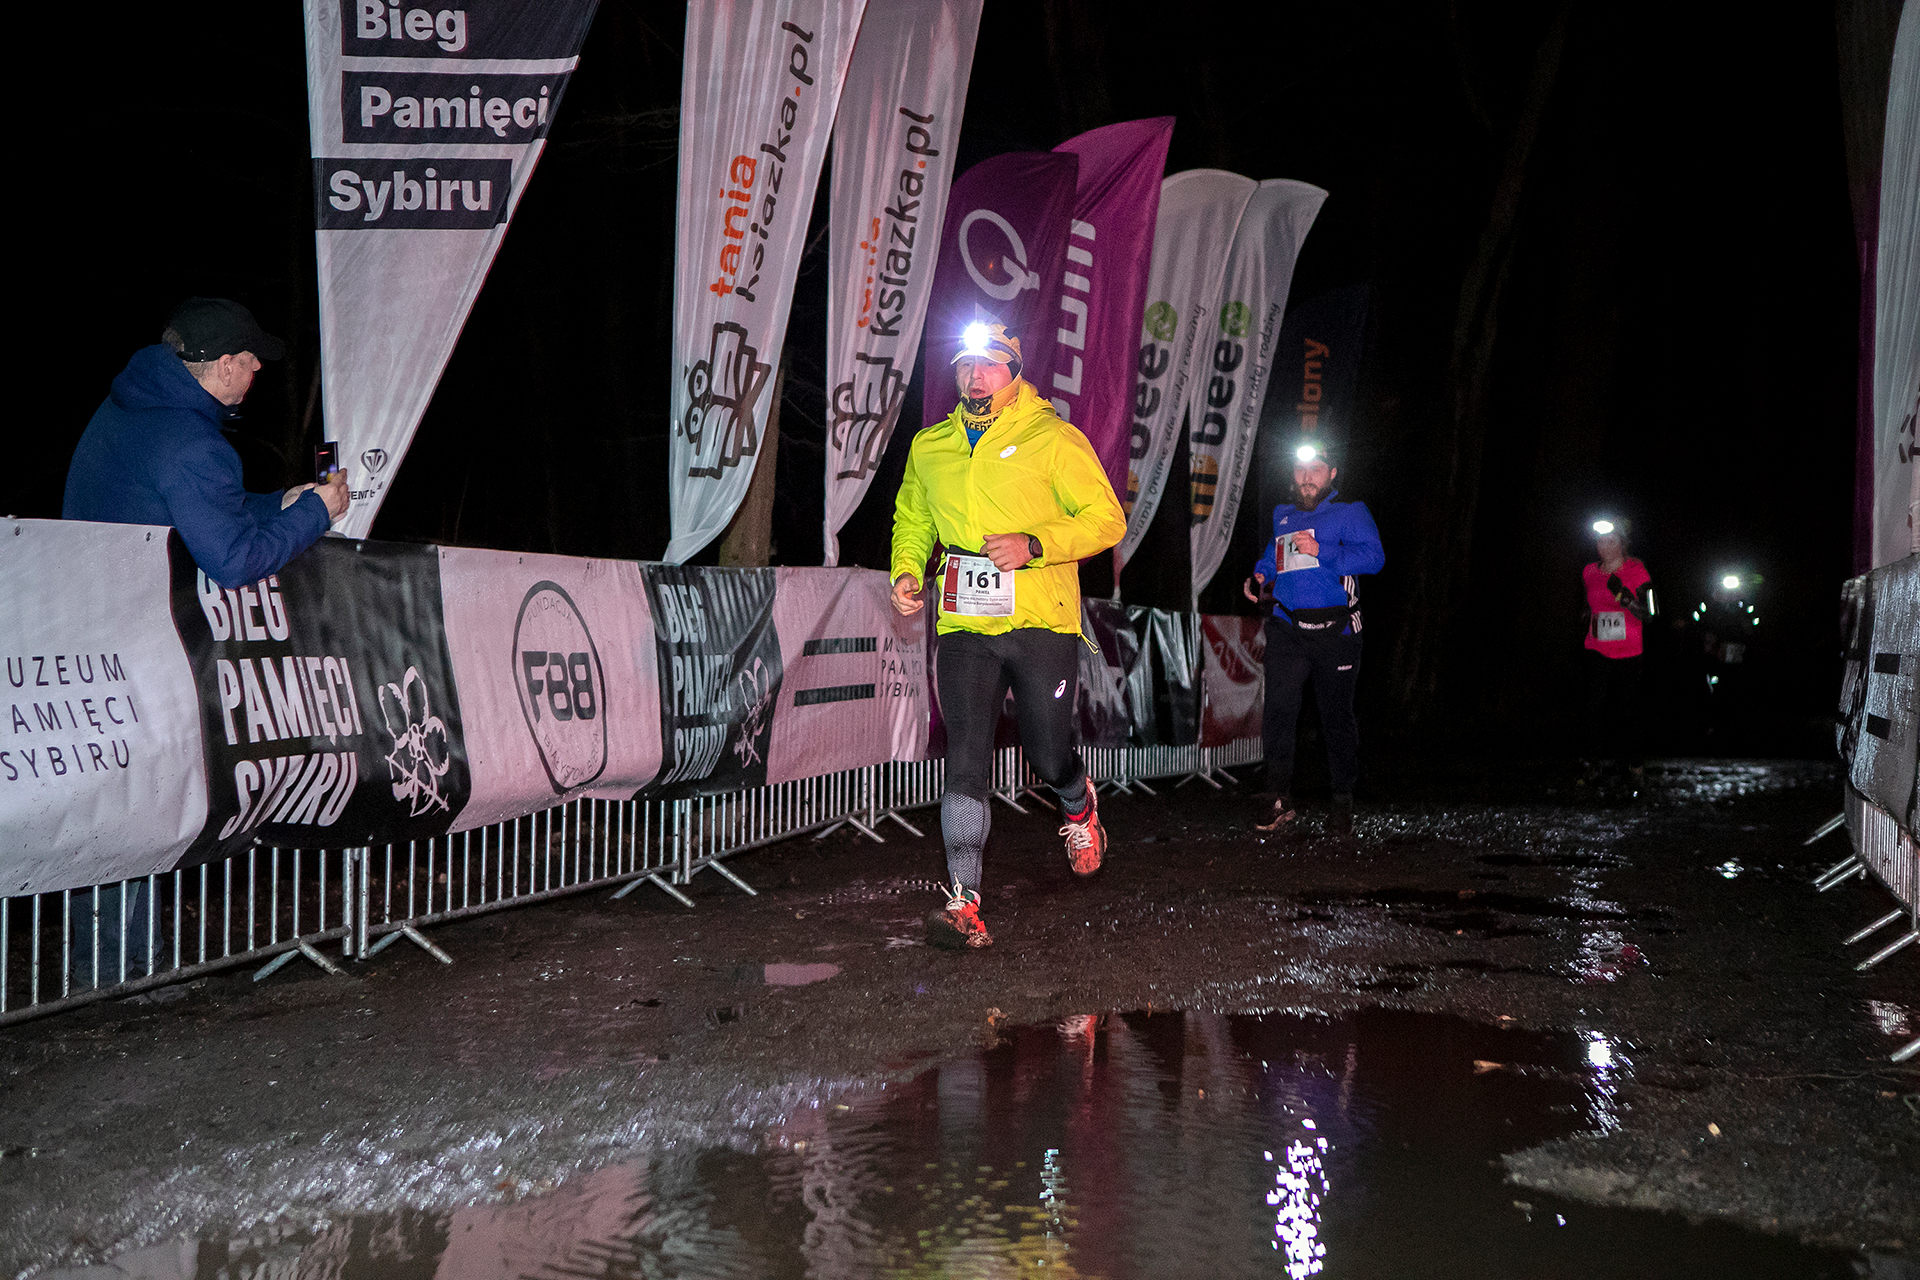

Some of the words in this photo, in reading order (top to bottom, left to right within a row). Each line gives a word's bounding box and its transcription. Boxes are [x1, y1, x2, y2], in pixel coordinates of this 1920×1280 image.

[357, 0, 467, 51] Bieg
[360, 85, 548, 137] Pamięci
[736, 21, 814, 302] ksiazka.pl
[328, 168, 493, 221] Sybiru
[709, 155, 757, 297] tania
[870, 107, 940, 336] ksiazka.pl
[1192, 340, 1244, 446] bee
[197, 566, 290, 642] BIEG
[965, 570, 1001, 589] 161
[659, 584, 707, 644] BIEG
[7, 653, 127, 688] UZEUM
[216, 655, 364, 747] PAMIĘCI
[522, 650, 597, 724] F88
[672, 653, 736, 721] PAMIĘCI
[11, 695, 139, 735] AMIĘCI
[0, 738, 130, 782] SYBIRU
